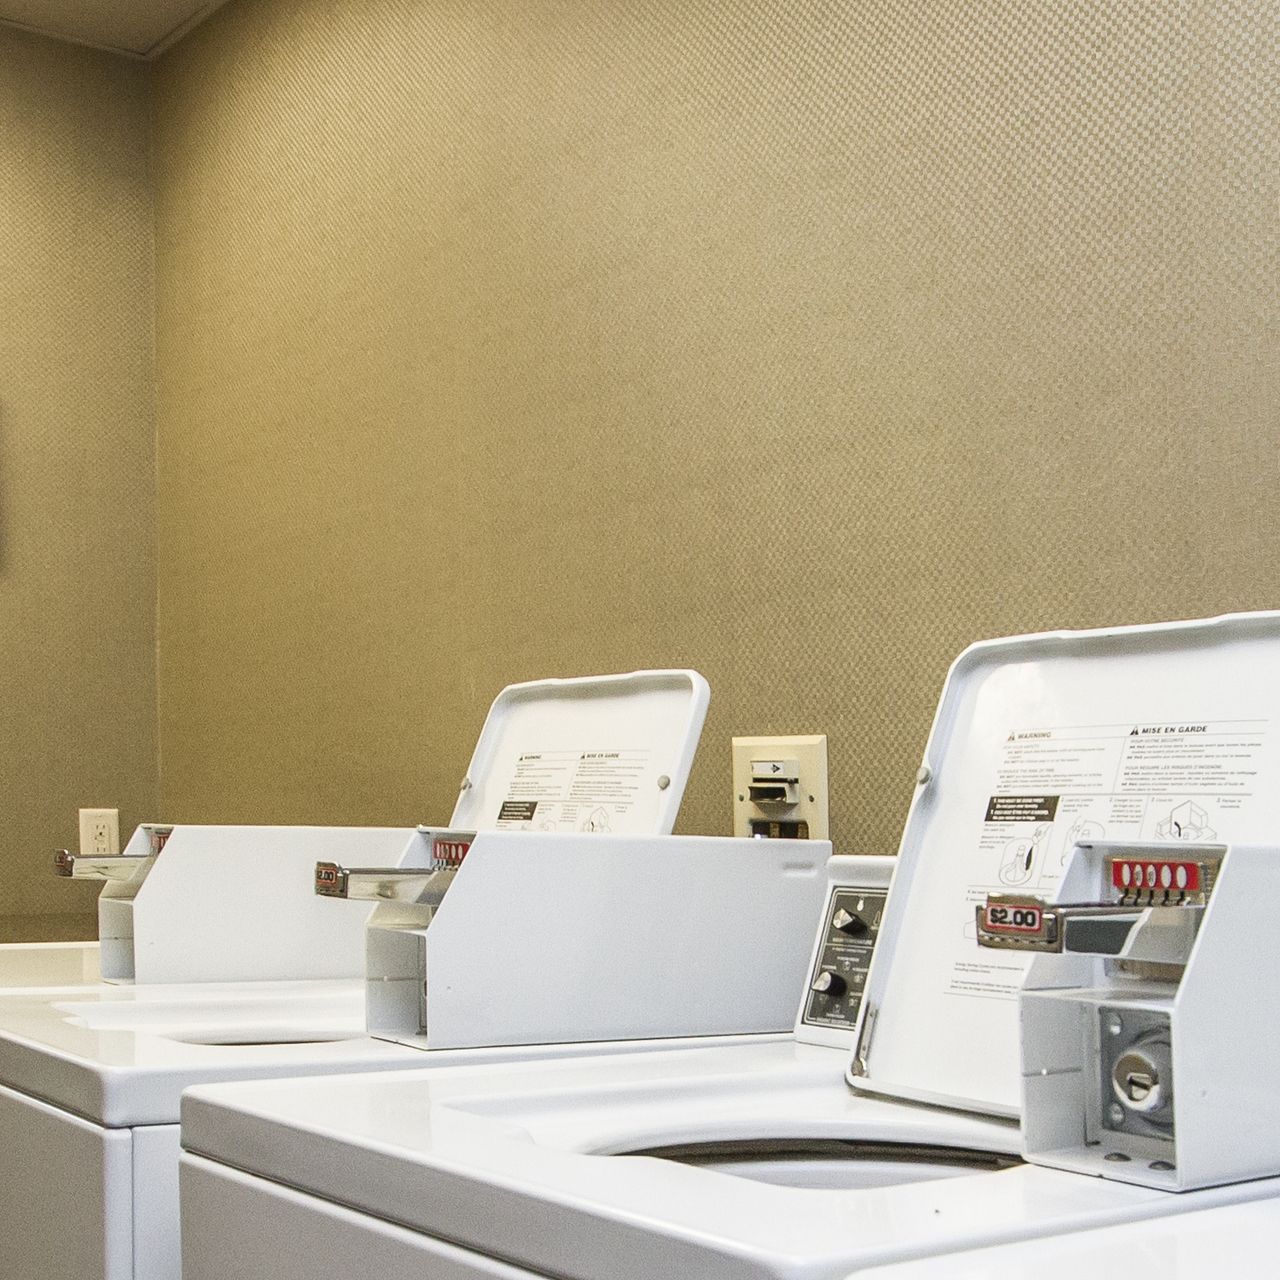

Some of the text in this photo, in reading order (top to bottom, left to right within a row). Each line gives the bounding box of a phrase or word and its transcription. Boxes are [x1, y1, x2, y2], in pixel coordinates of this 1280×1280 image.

[1141, 725, 1208, 735] MISE EN GARDE
[1018, 731, 1052, 740] WARNING
[990, 907, 1036, 927] $2.00
